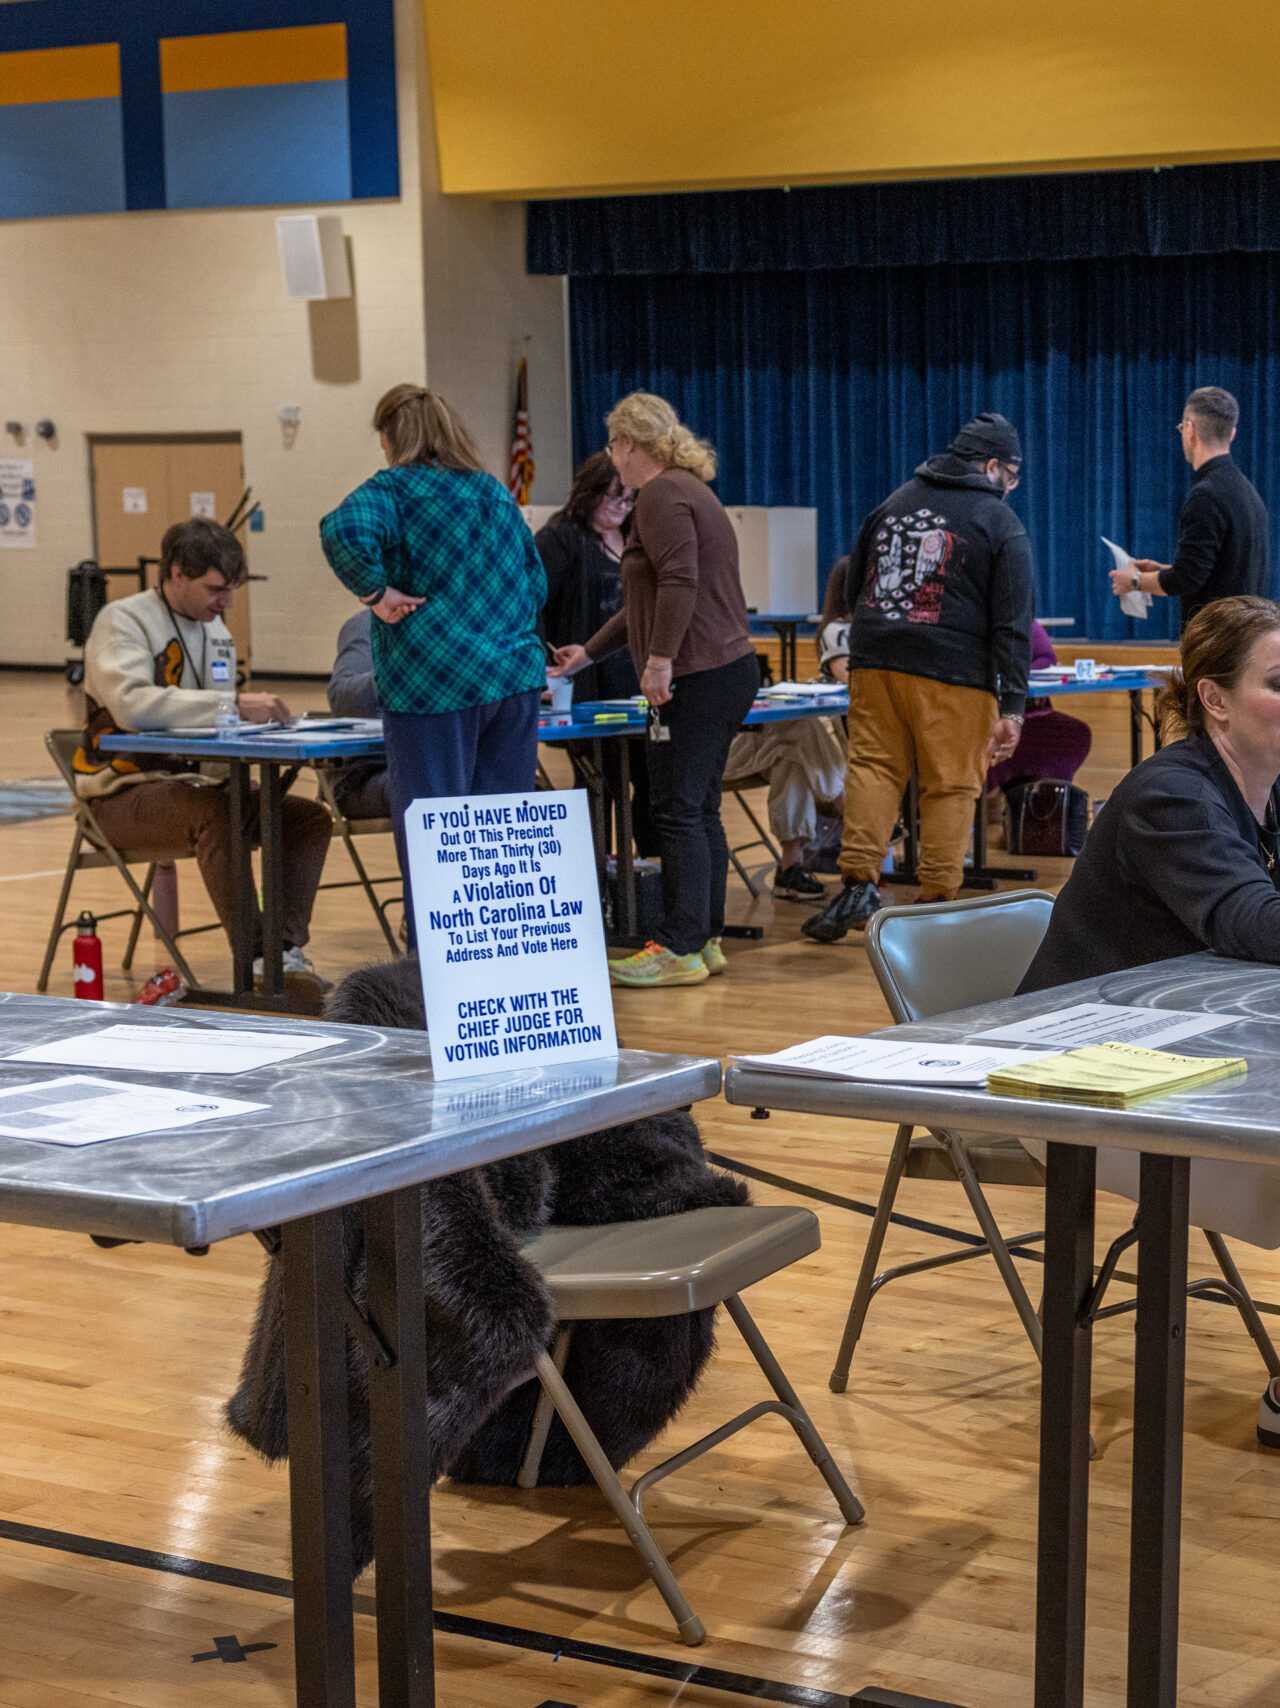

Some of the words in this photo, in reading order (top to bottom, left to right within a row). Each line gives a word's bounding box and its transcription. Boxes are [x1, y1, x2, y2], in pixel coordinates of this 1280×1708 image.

[422, 813, 435, 830] IF
[439, 811, 470, 829] YOU
[474, 808, 512, 826] HAVE
[515, 804, 567, 823] MOVED
[440, 832, 461, 846] Out
[463, 830, 476, 844] Of
[478, 829, 504, 843] This
[506, 824, 554, 841] Precinct
[437, 849, 467, 863] More
[469, 847, 499, 860] Than
[500, 843, 534, 859] Thirty
[538, 840, 561, 858] (30)
[462, 865, 491, 880] Days
[494, 862, 516, 878] Ago
[519, 860, 528, 873] It
[530, 858, 541, 872] Is
[453, 890, 462, 904] A
[463, 879, 535, 902] Violation
[539, 875, 556, 895] Of
[429, 908, 474, 930] North
[479, 903, 546, 925] Carolina
[550, 899, 583, 917] Law
[448, 931, 463, 945] To
[466, 929, 488, 944] List
[490, 927, 518, 941] Your
[521, 921, 571, 938] Previous
[446, 948, 493, 963] Address
[497, 942, 519, 957] And
[521, 940, 548, 954] Vote
[550, 937, 578, 951] Here
[458, 997, 507, 1019] CHECK
[509, 992, 548, 1012] WITH
[551, 988, 579, 1006] THE
[458, 1018, 500, 1040] CHIEF
[504, 1012, 552, 1034] JUDGE
[555, 1008, 584, 1026] FOR
[444, 1039, 499, 1062] VOTING
[503, 1025, 602, 1054] INFORMATION
